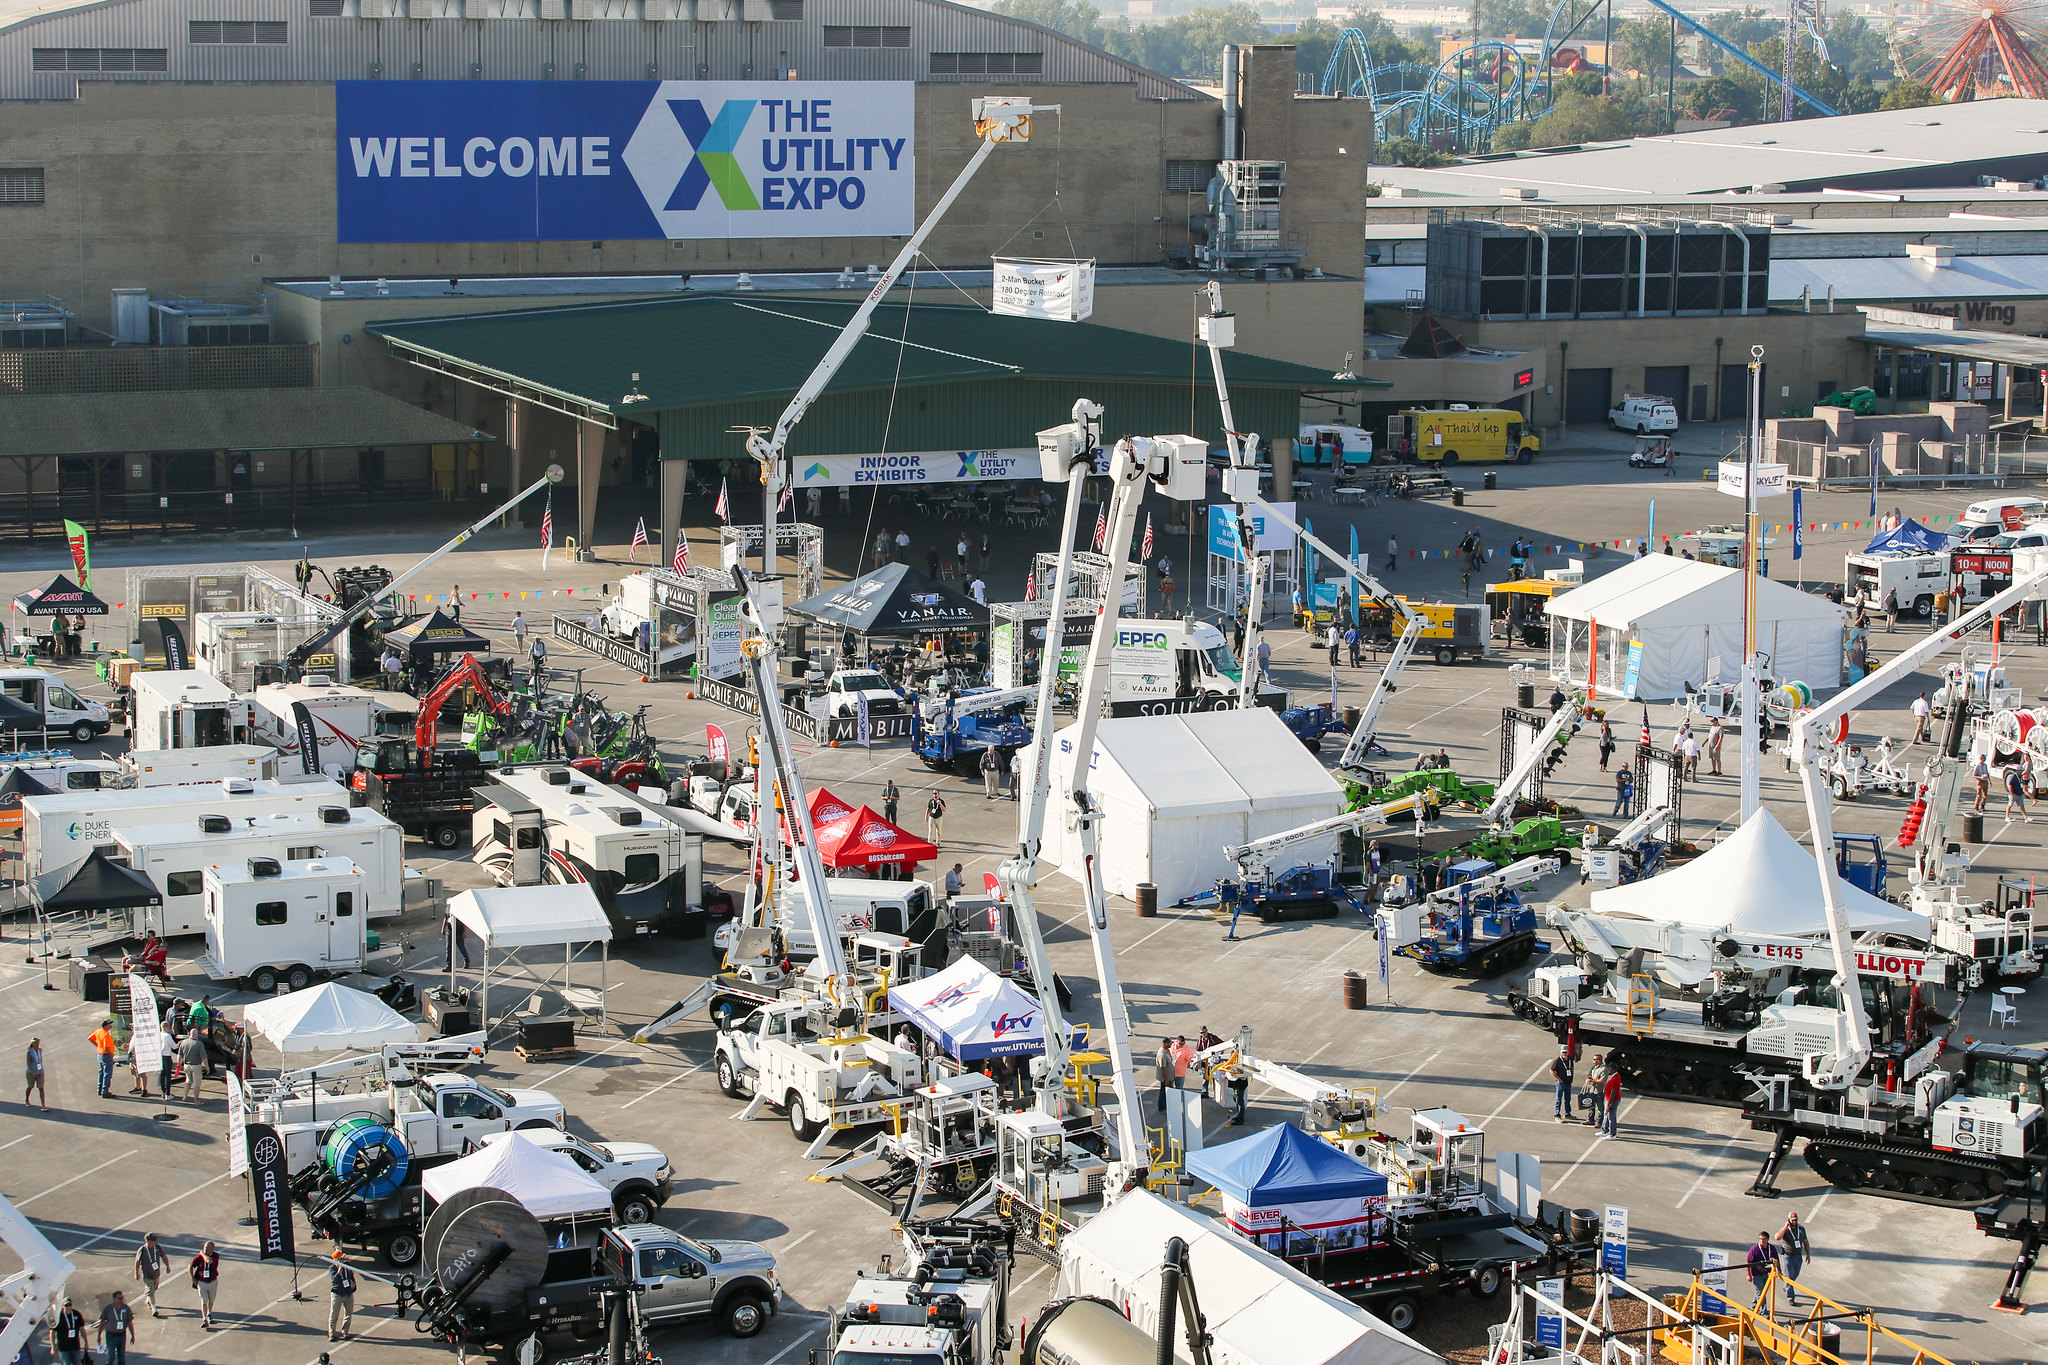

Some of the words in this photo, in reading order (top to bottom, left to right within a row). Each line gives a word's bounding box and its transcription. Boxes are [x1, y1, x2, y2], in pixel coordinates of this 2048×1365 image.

[761, 100, 831, 132] THE
[349, 136, 611, 178] WELCOME
[762, 137, 906, 171] UTILITY
[762, 177, 866, 210] EXPO
[1001, 275, 1022, 284] 2-Man
[1022, 277, 1046, 286] Bucket
[870, 274, 892, 301] KODIAK
[1001, 286, 1013, 294] 180
[1966, 301, 2016, 326] Wing
[1424, 424, 1441, 434] All
[1444, 421, 1480, 434] Thai'd
[1484, 424, 1499, 438] Up
[980, 450, 998, 459] THE
[860, 456, 920, 469] INDOOR
[980, 458, 1016, 468] UTILITY
[854, 469, 926, 482] EXHIBITS
[980, 467, 1006, 477] EXPO
[1957, 559, 1970, 569] 10
[1985, 560, 2008, 569] NOON
[41, 592, 84, 602] AVANT
[668, 584, 695, 605] VANAIR
[142, 606, 186, 615] BRON
[897, 607, 969, 619] VANAIR
[1966, 612, 1989, 631] TEREX
[919, 626, 950, 634] vanair.com
[557, 620, 580, 645] MOBILE
[582, 634, 606, 656] POWER
[608, 644, 648, 674] SOLUTIONS
[1119, 631, 1168, 651] EPEQ
[702, 680, 732, 705] MOBILE
[85, 821, 109, 831] DUKE
[868, 853, 906, 863] BOSSair.com
[1766, 944, 1804, 960] E145
[1855, 952, 1926, 977] LLIOTT
[991, 1016, 1033, 1033] UTV
[991, 1042, 1046, 1053] www.UTVint.c
[1239, 1209, 1281, 1221] ACHIEVER
[443, 1248, 477, 1280] ZAYO
